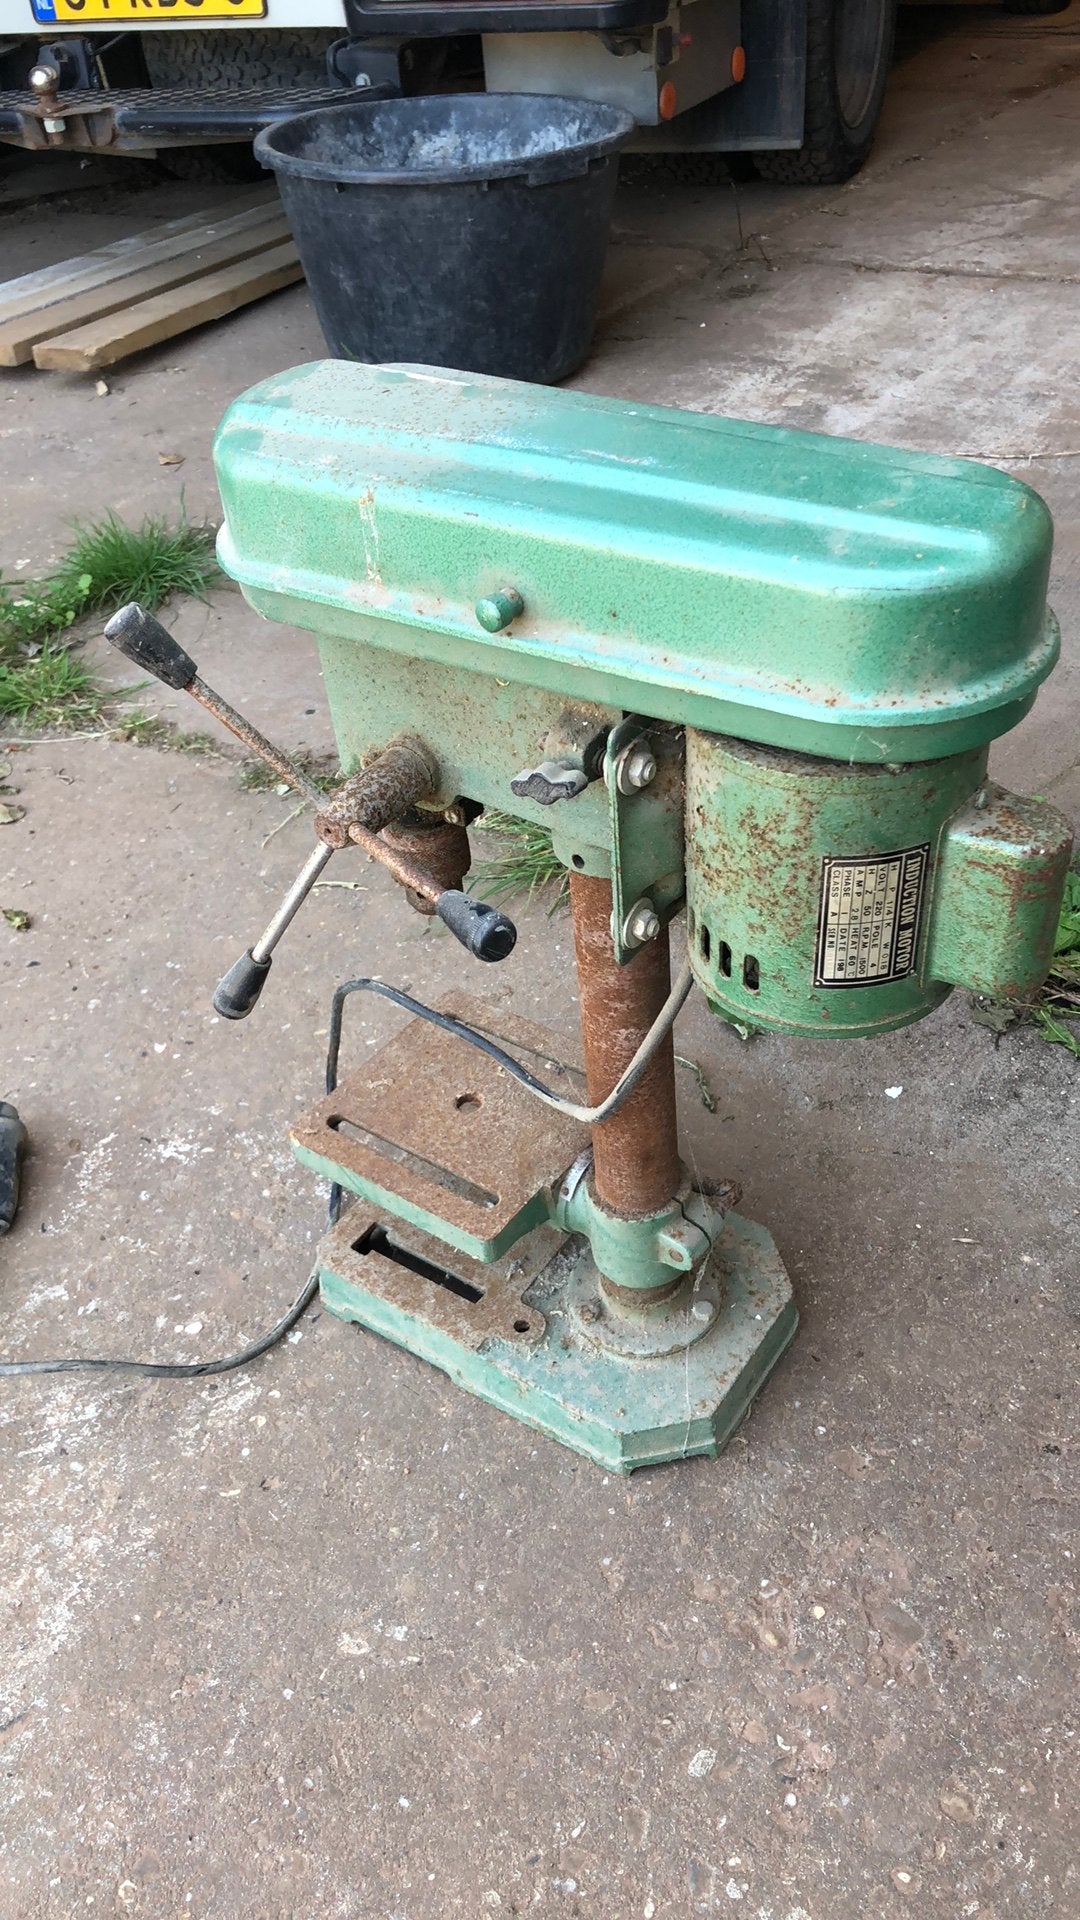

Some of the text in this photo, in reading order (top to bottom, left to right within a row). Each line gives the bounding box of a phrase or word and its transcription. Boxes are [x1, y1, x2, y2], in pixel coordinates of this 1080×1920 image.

[831, 869, 841, 898] CLASS
[843, 869, 852, 898] PHASE
[874, 866, 887, 917] VOLT 220
[863, 905, 872, 916] 50
[885, 901, 893, 915] 1/4
[895, 856, 922, 972] INDUCTION MOTOR
[838, 928, 847, 952] DATE
[850, 927, 859, 950] HEAT
[871, 925, 880, 949] POLE
[847, 955, 857, 966] 60
[858, 957, 867, 975] 1500
